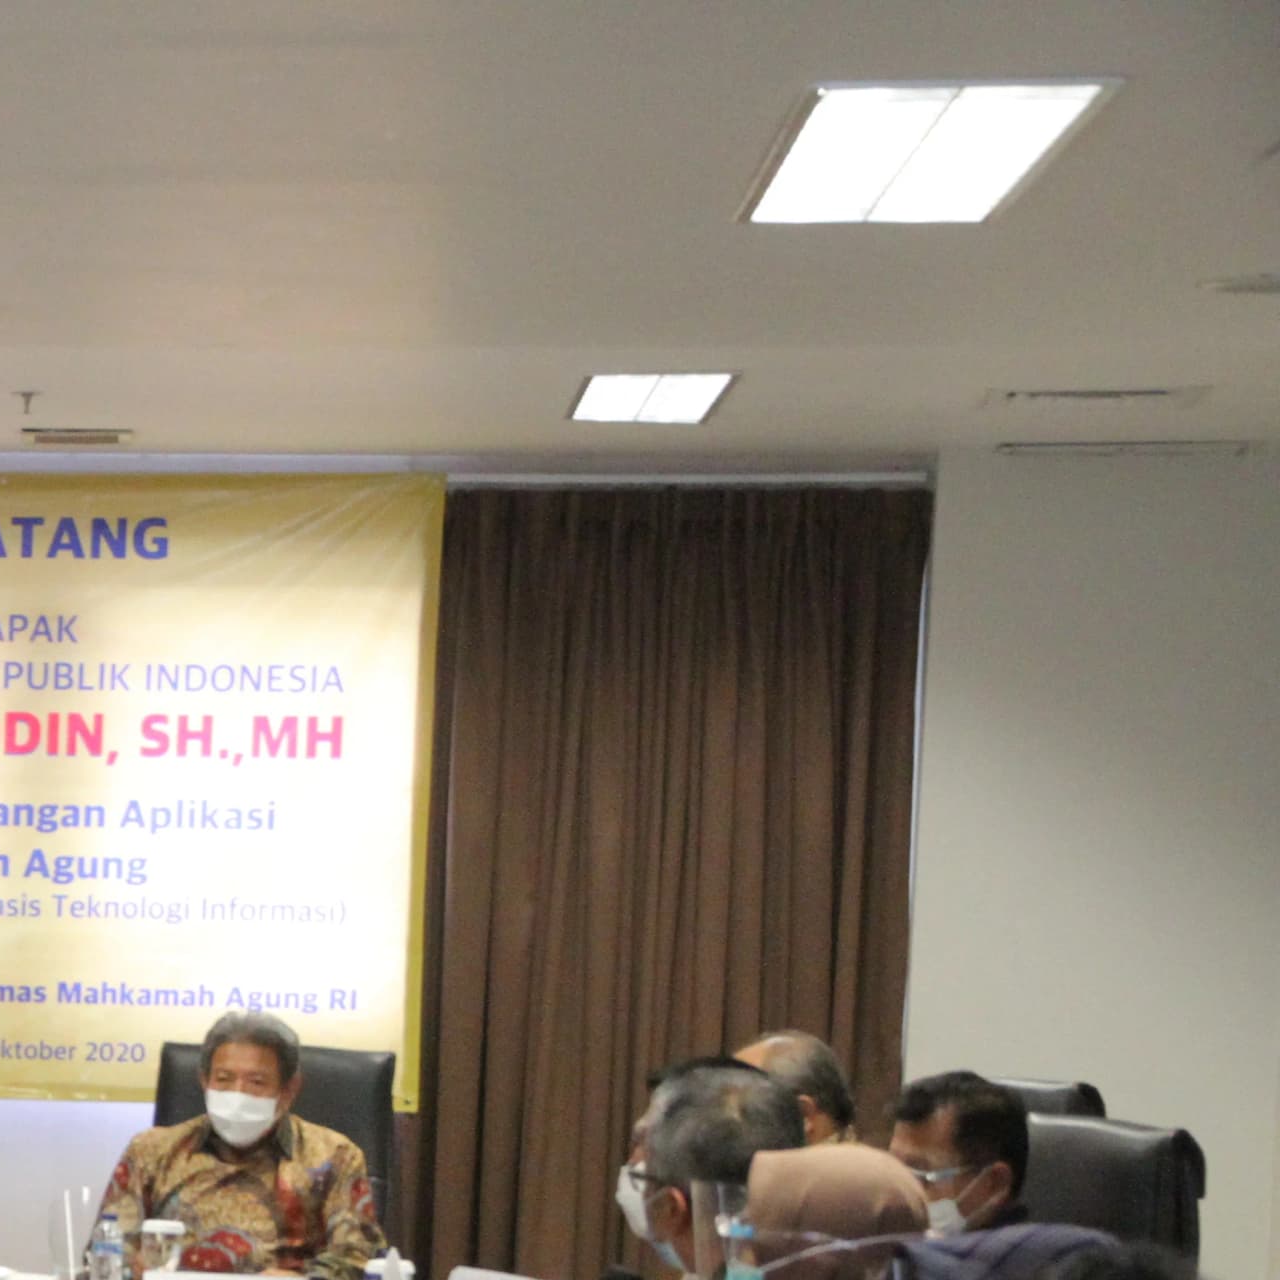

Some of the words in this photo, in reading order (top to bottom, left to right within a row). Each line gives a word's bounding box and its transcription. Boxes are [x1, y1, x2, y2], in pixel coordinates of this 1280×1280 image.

[146, 664, 344, 693] INDONESIA
[120, 800, 275, 835] Aplikasi
[23, 848, 147, 885] Agung
[51, 892, 189, 924] Teknologi
[202, 896, 346, 924] Informasi)
[57, 981, 214, 1006] Mahkamah
[224, 986, 319, 1013] Agung
[329, 989, 357, 1010] RI
[85, 1041, 146, 1064] 2020
